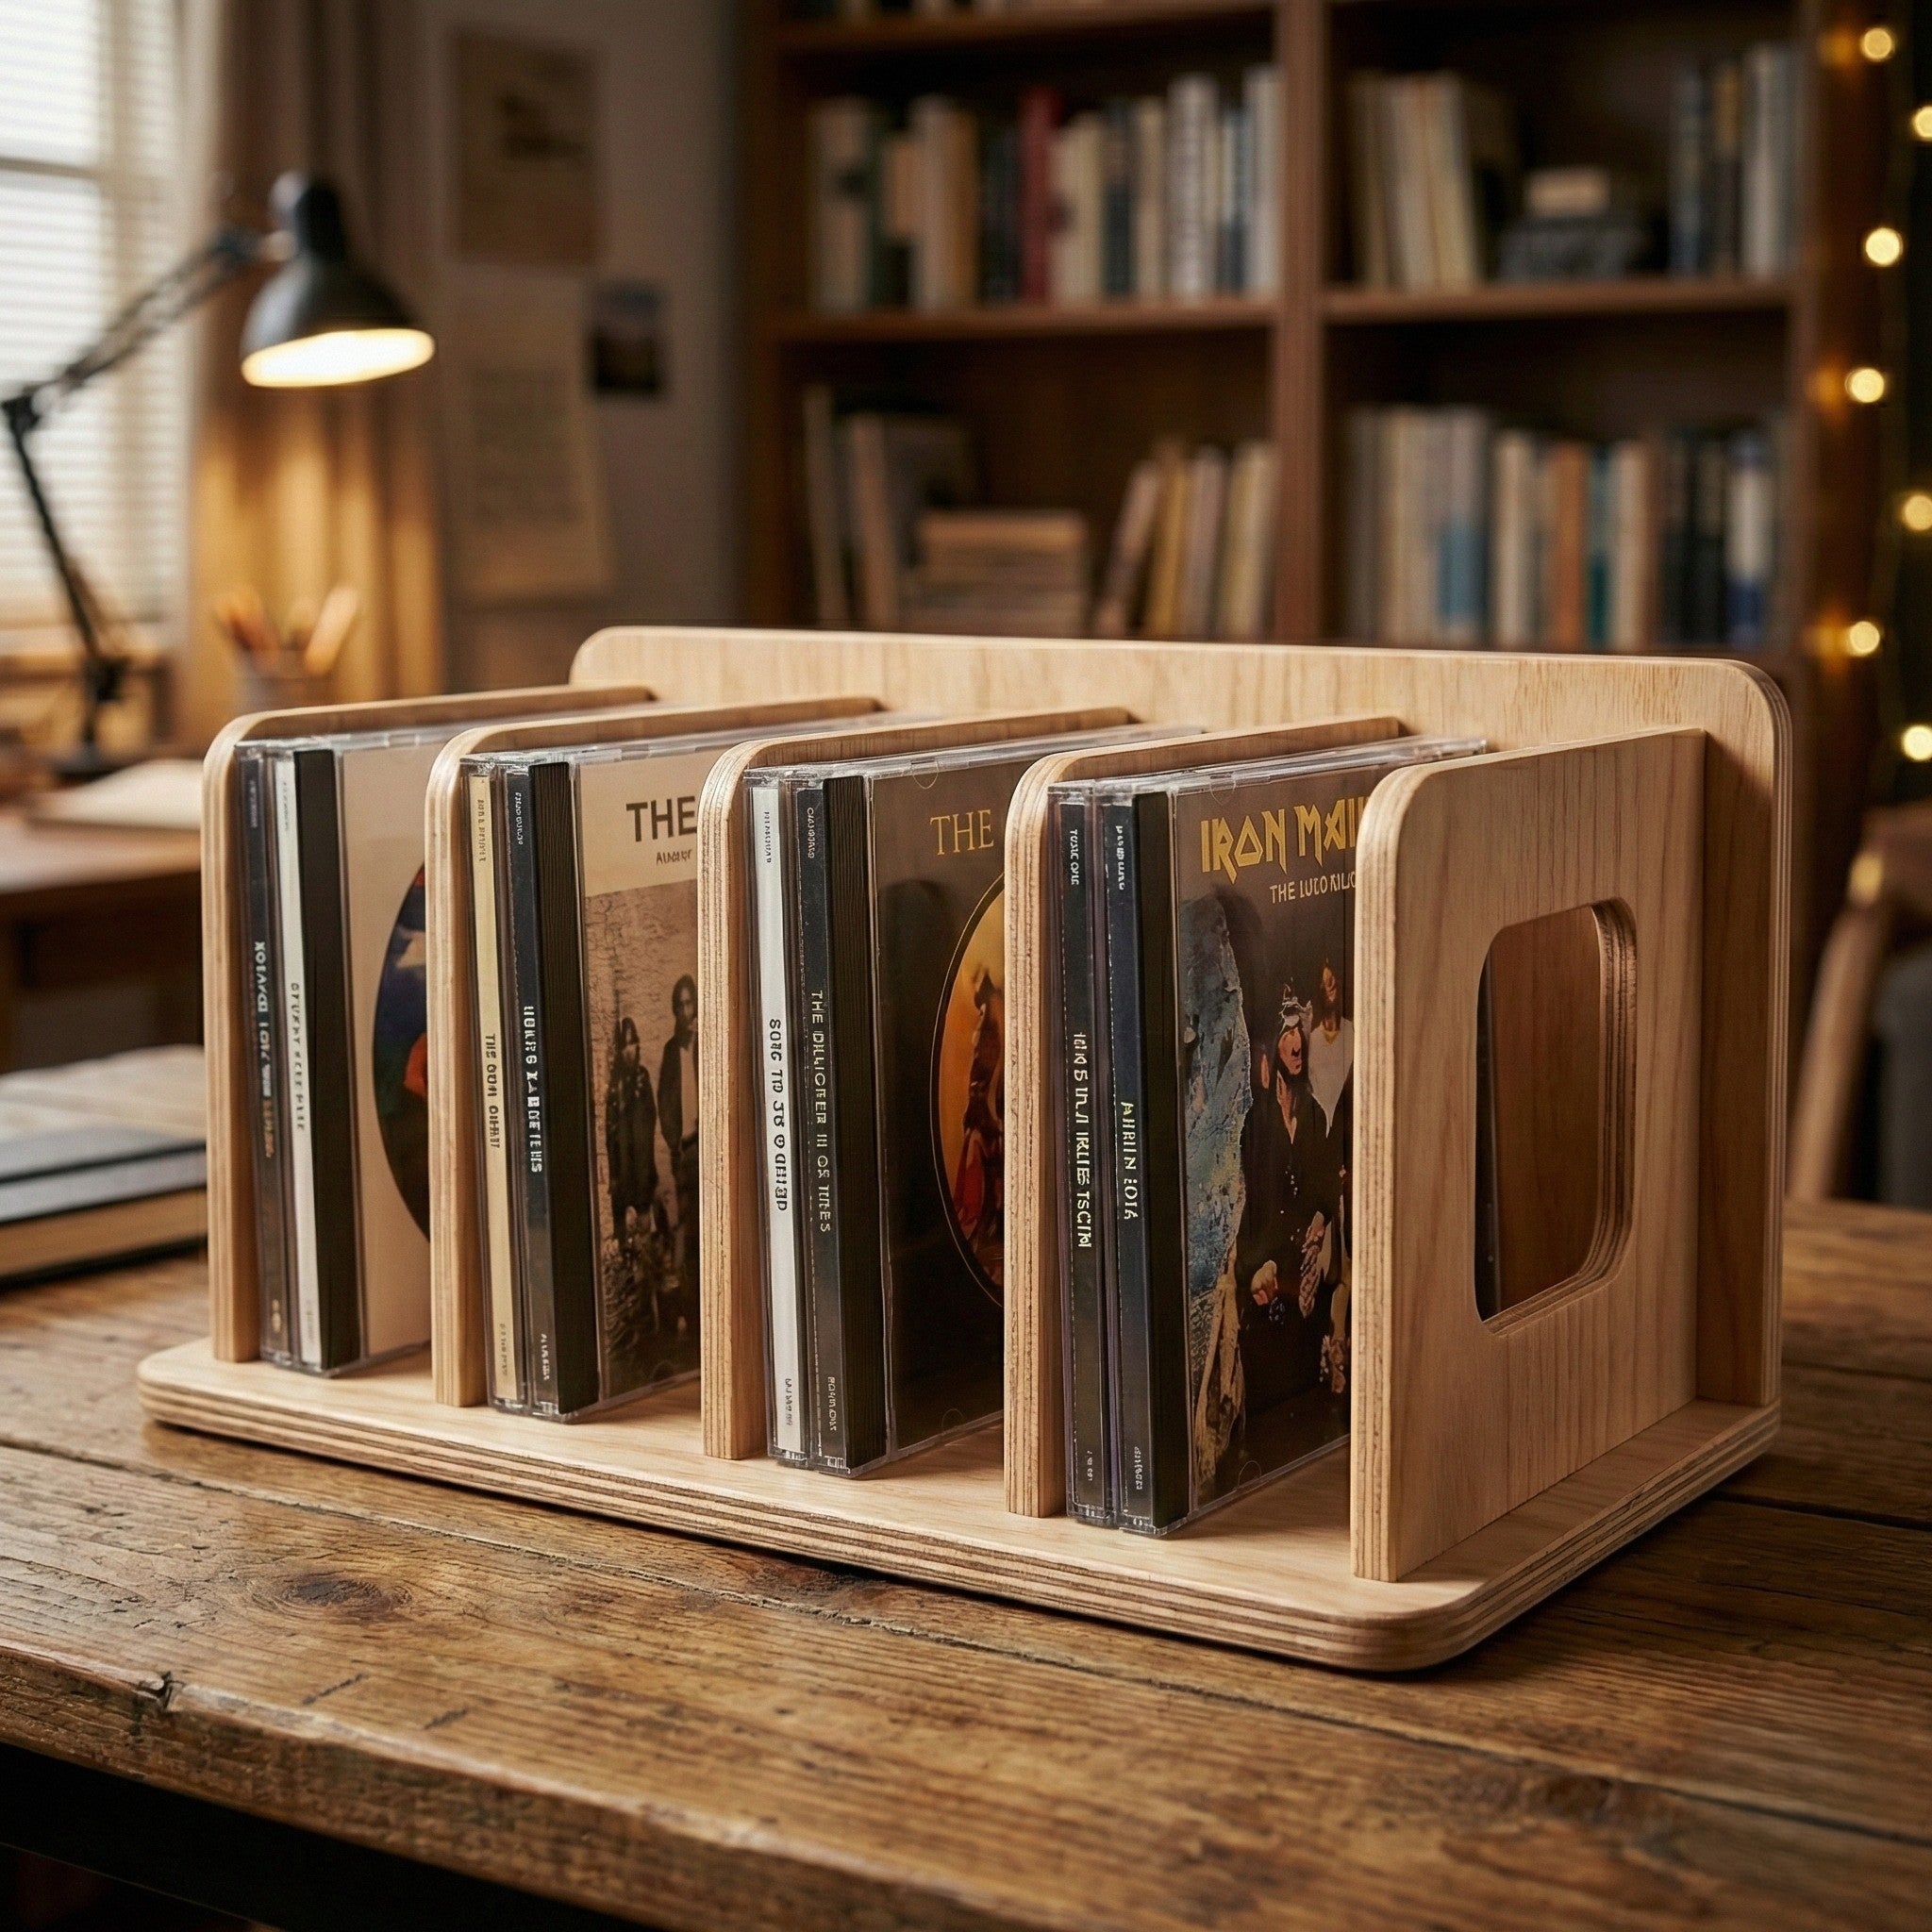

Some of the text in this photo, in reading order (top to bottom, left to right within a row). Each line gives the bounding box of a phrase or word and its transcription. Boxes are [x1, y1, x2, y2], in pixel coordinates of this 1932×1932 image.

[625, 796, 697, 842] THE
[929, 808, 994, 856] THE
[1200, 808, 1287, 884] IRON
[1269, 881, 1296, 904] THE
